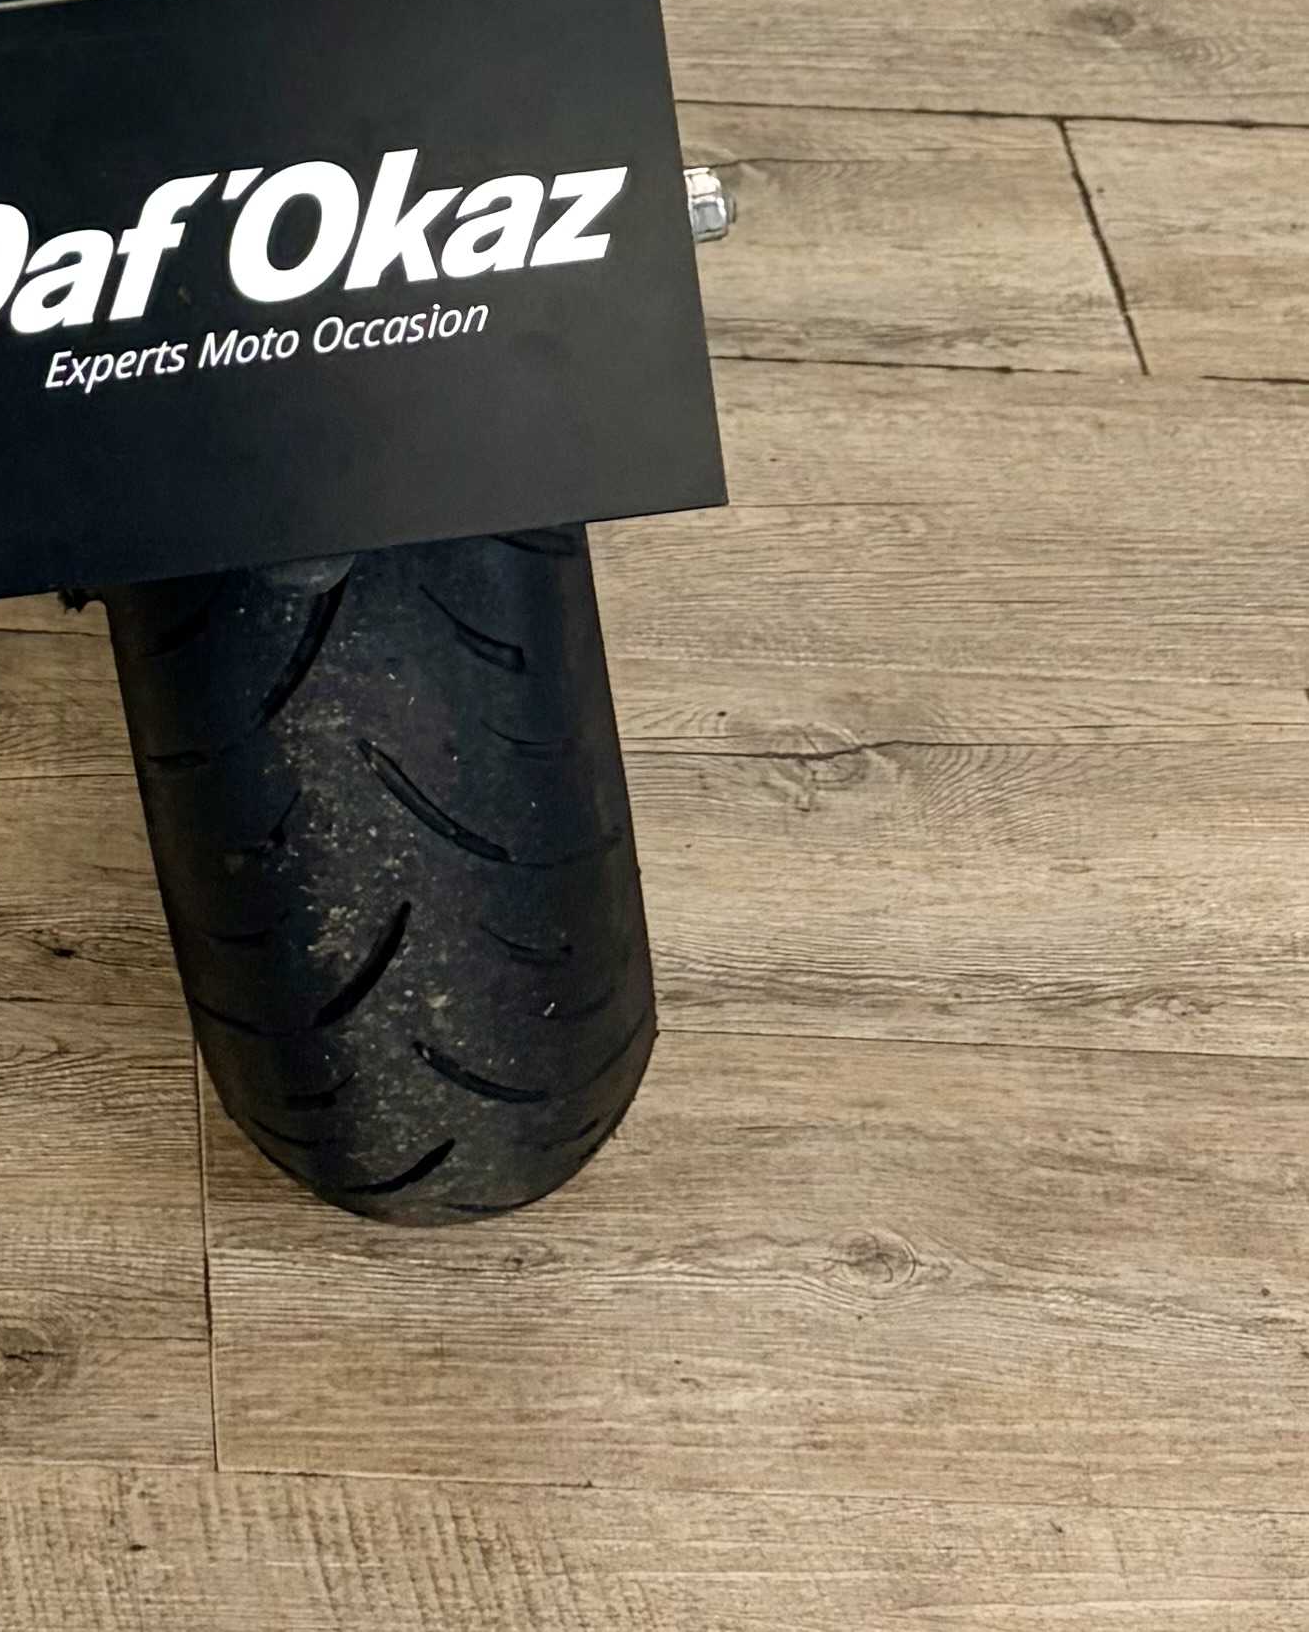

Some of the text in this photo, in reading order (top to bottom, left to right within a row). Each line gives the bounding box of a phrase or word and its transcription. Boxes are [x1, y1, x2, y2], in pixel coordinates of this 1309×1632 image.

[44, 303, 490, 393] Experts Moto Occasion
